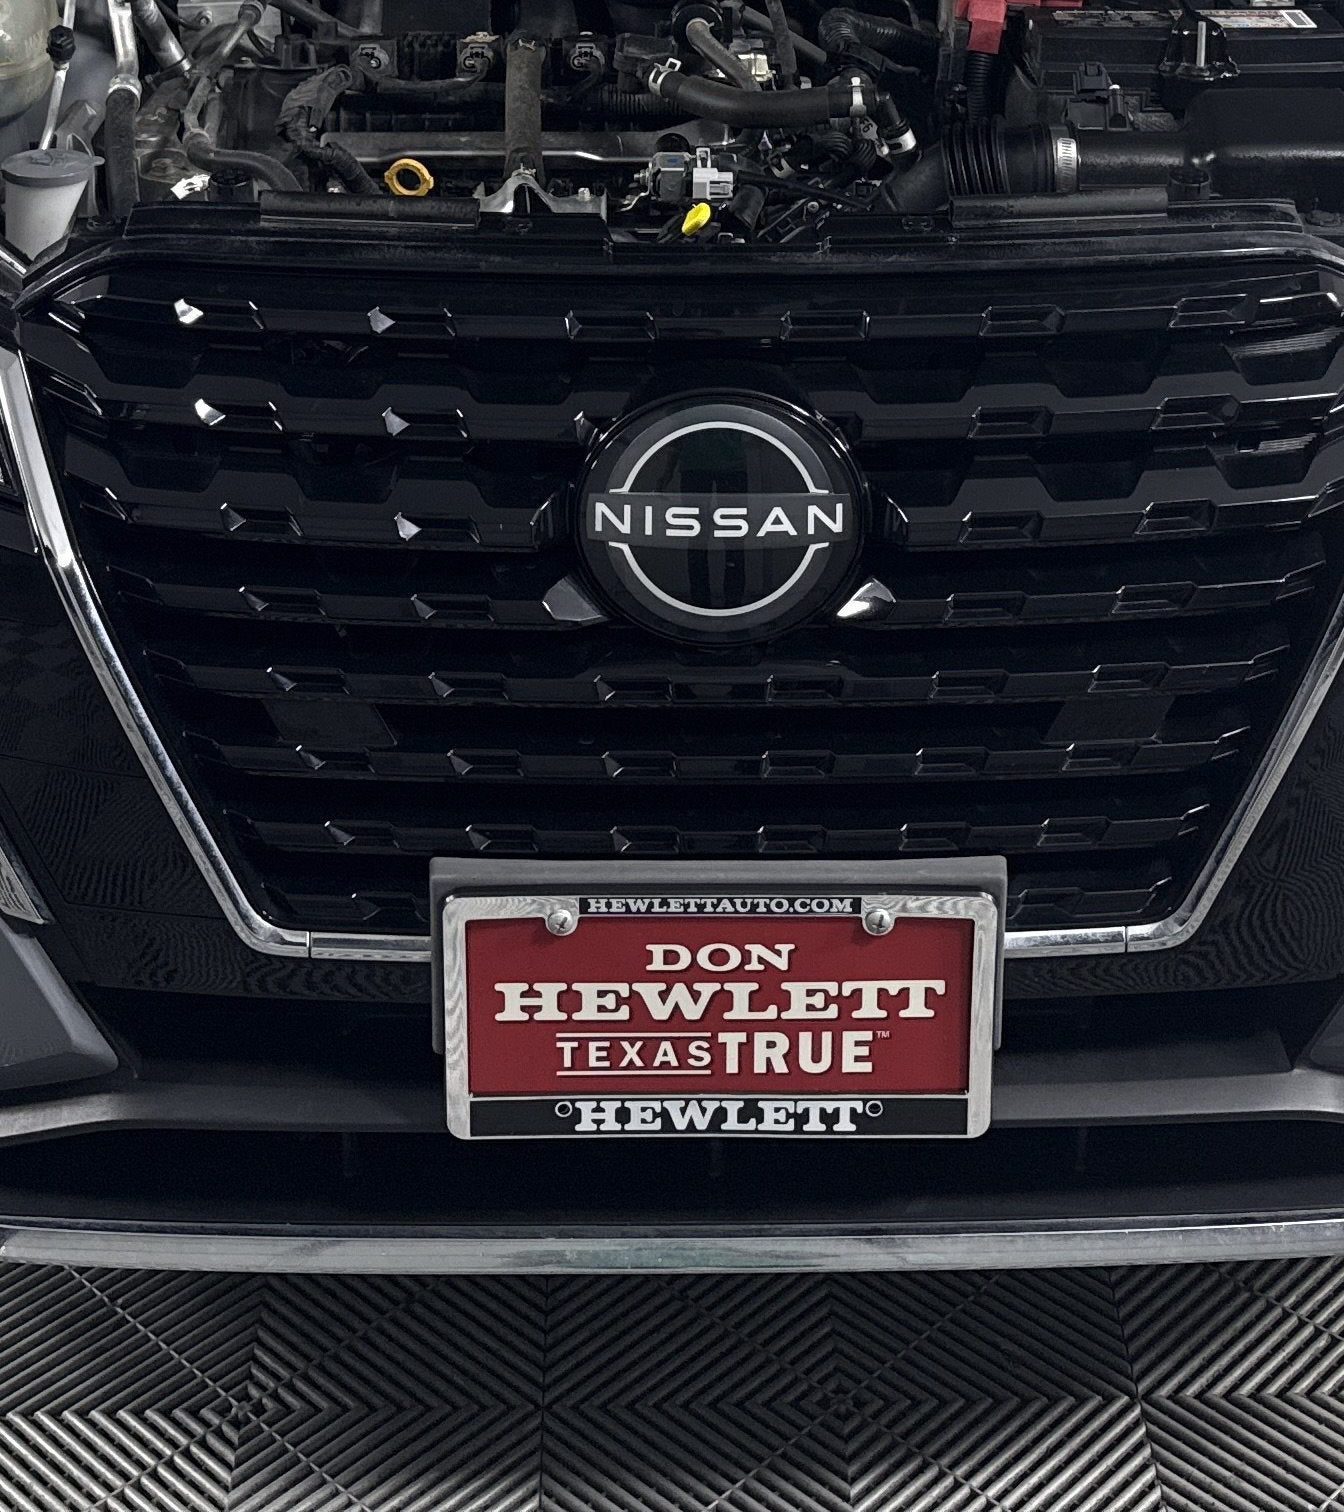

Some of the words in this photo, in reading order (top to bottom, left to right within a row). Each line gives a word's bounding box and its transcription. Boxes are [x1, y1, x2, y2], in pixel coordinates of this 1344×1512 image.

[594, 501, 843, 538] NISSAN
[587, 898, 853, 913] HEWLETTAUTO.COM
[645, 942, 796, 972] DON
[494, 979, 946, 1022] HEWLETT
[556, 1040, 712, 1068] TEXAS
[719, 1030, 873, 1074] TRUE
[574, 1099, 864, 1132] HEWLETT
